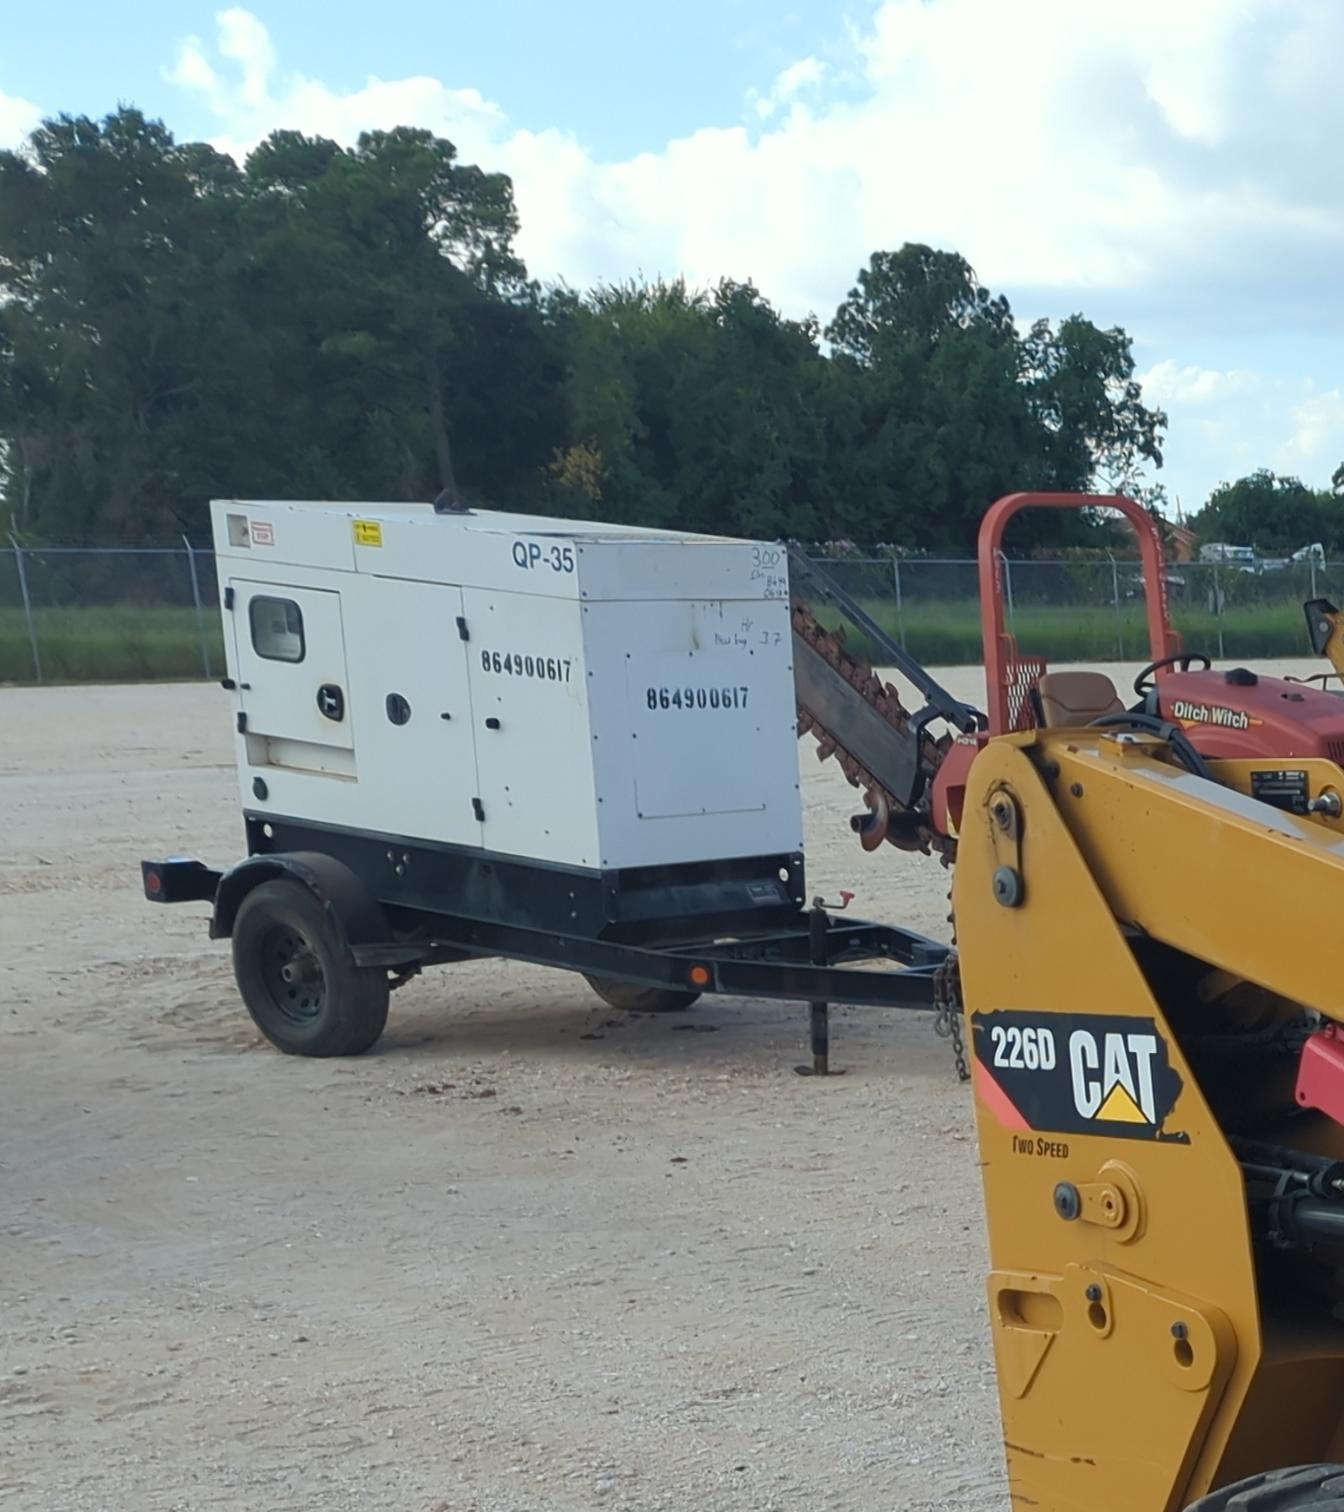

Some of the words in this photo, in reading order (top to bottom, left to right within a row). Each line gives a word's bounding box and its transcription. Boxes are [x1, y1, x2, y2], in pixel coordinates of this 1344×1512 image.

[512, 541, 574, 573] QP-35
[481, 649, 571, 682] 864900617
[646, 686, 748, 710] 864900617
[1174, 701, 1209, 722] Ditch
[1210, 705, 1249, 729] Witch
[991, 1026, 1056, 1070] 226D
[1069, 1030, 1158, 1124] CAT
